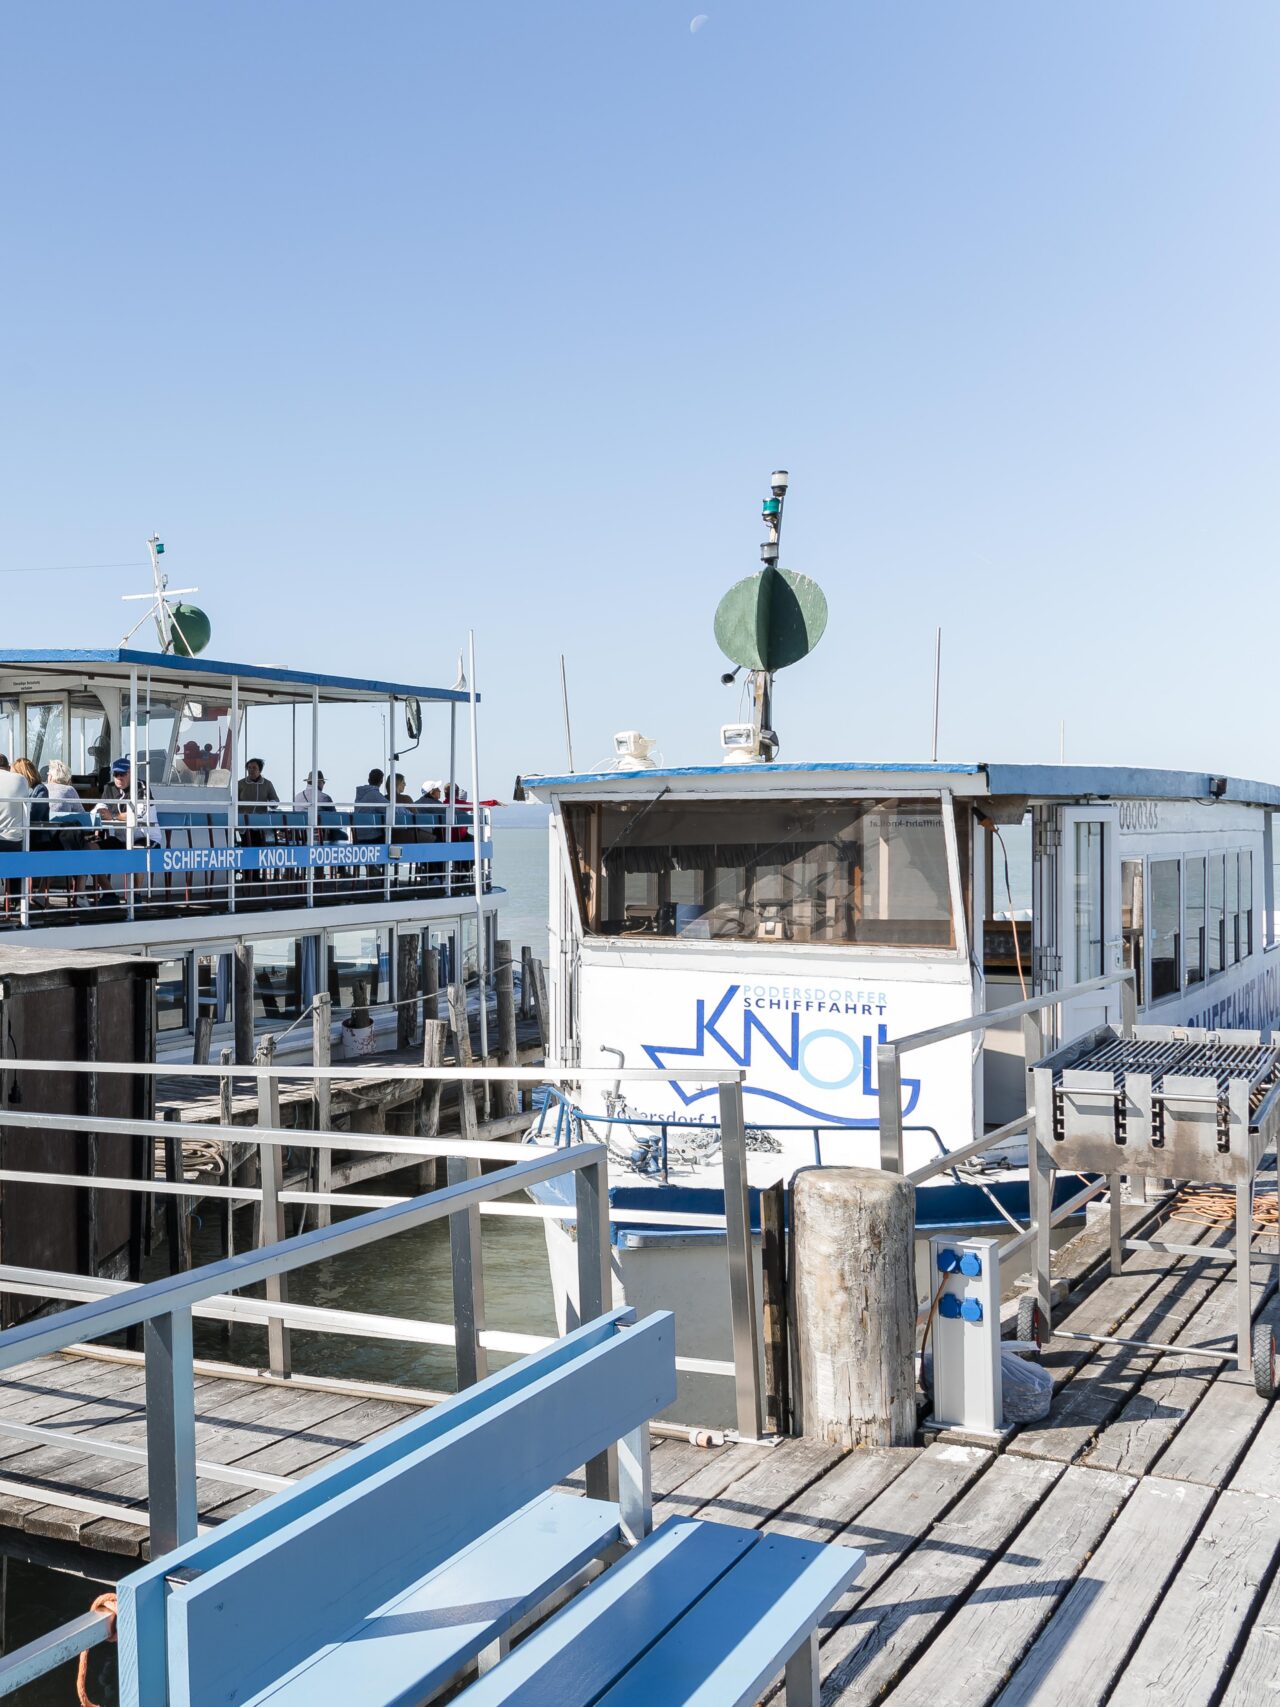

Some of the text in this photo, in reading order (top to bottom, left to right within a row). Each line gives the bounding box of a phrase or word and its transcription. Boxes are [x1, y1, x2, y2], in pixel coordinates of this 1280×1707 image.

[163, 846, 381, 870] SCHIFFAHRT KNOLL PODERSDORF
[743, 985, 888, 1005] PODERSDORFER
[743, 997, 887, 1016] SCHIFFFAHRT
